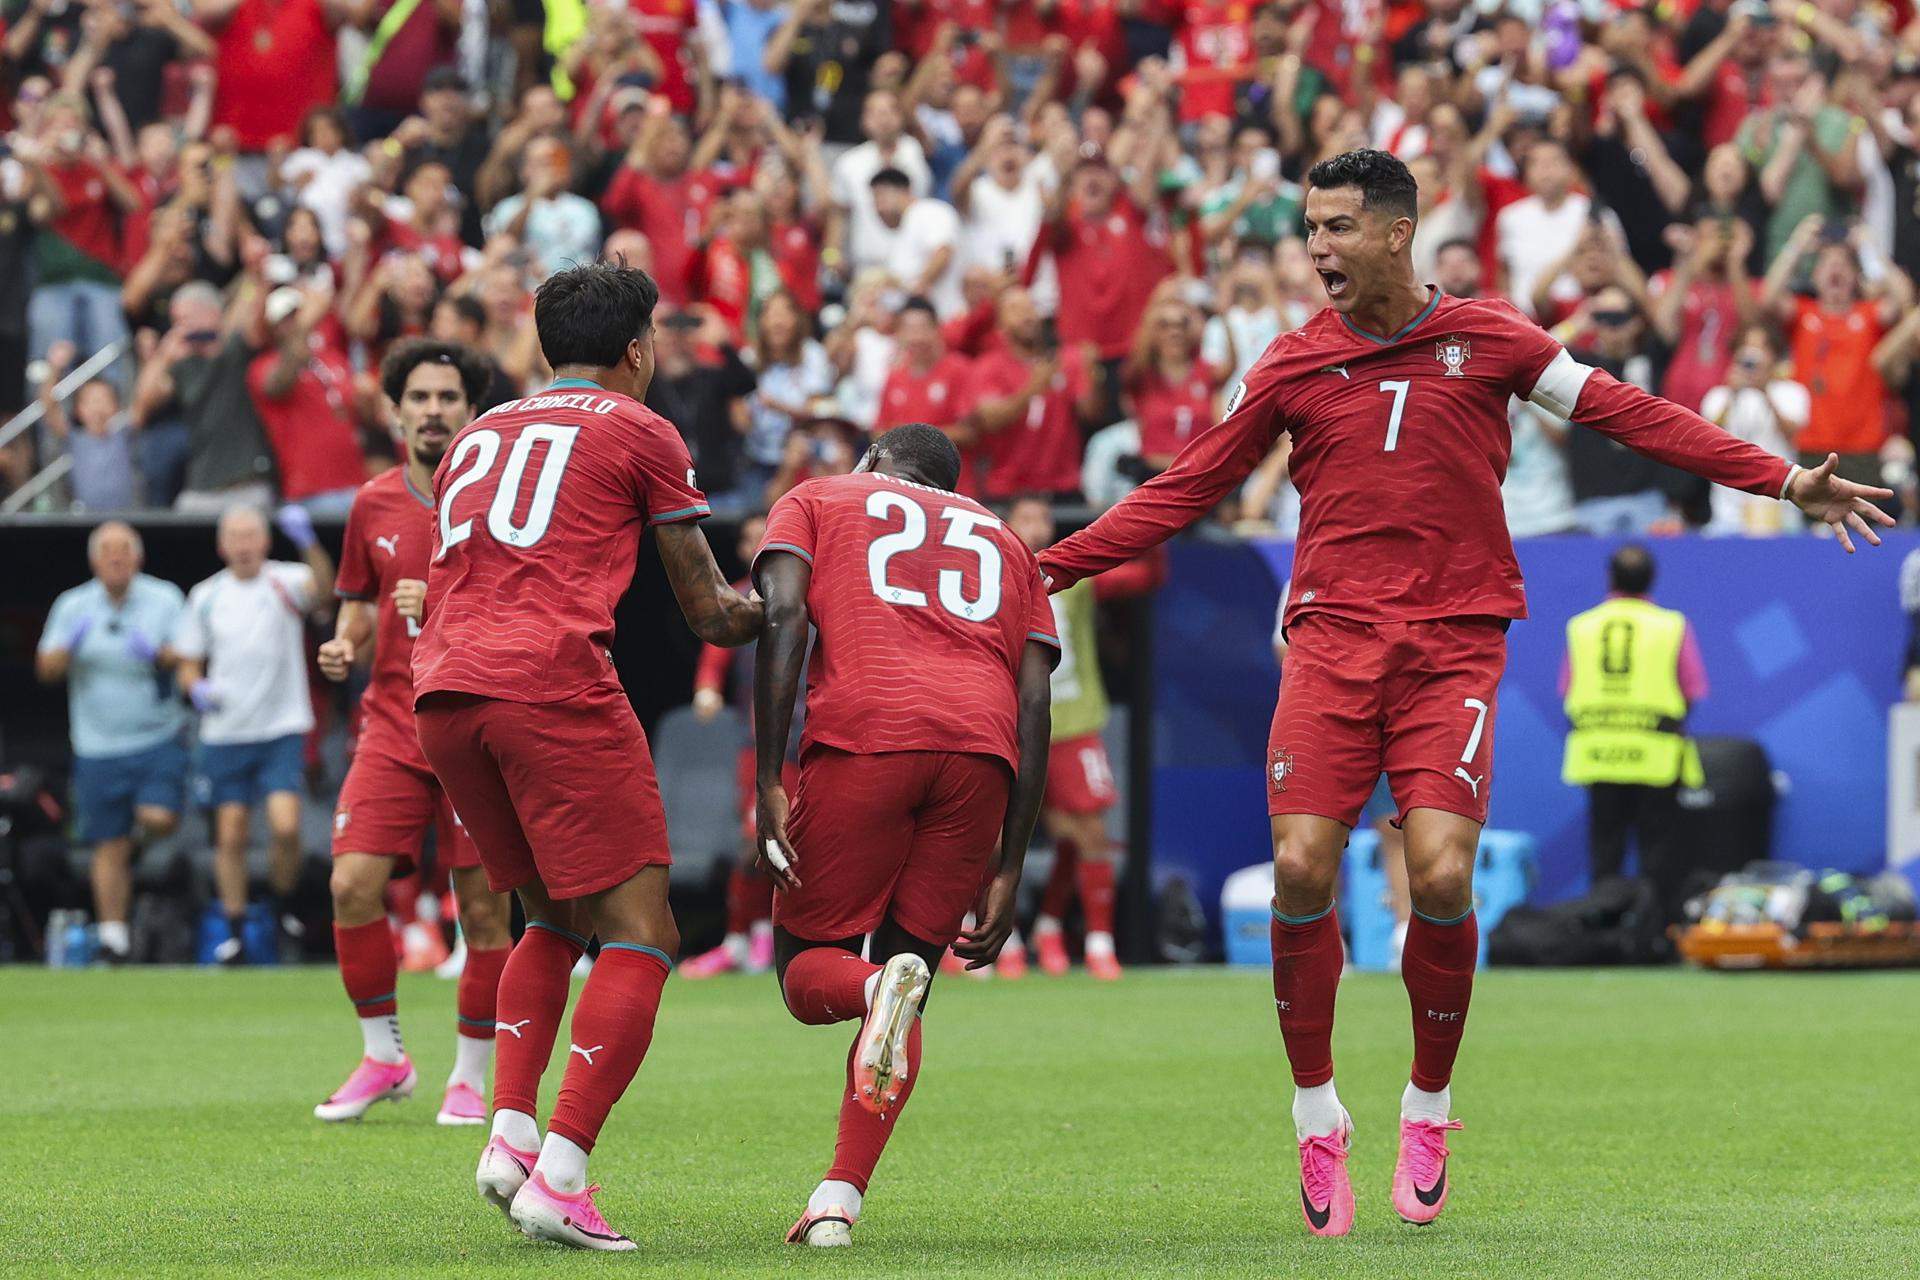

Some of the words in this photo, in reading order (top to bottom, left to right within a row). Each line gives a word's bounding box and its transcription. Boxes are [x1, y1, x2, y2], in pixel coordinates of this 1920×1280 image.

[517, 393, 619, 415] CANCELO
[1379, 380, 1411, 452] 7
[435, 422, 581, 560] 20
[865, 490, 1003, 622] 25
[1460, 698, 1489, 764] 7
